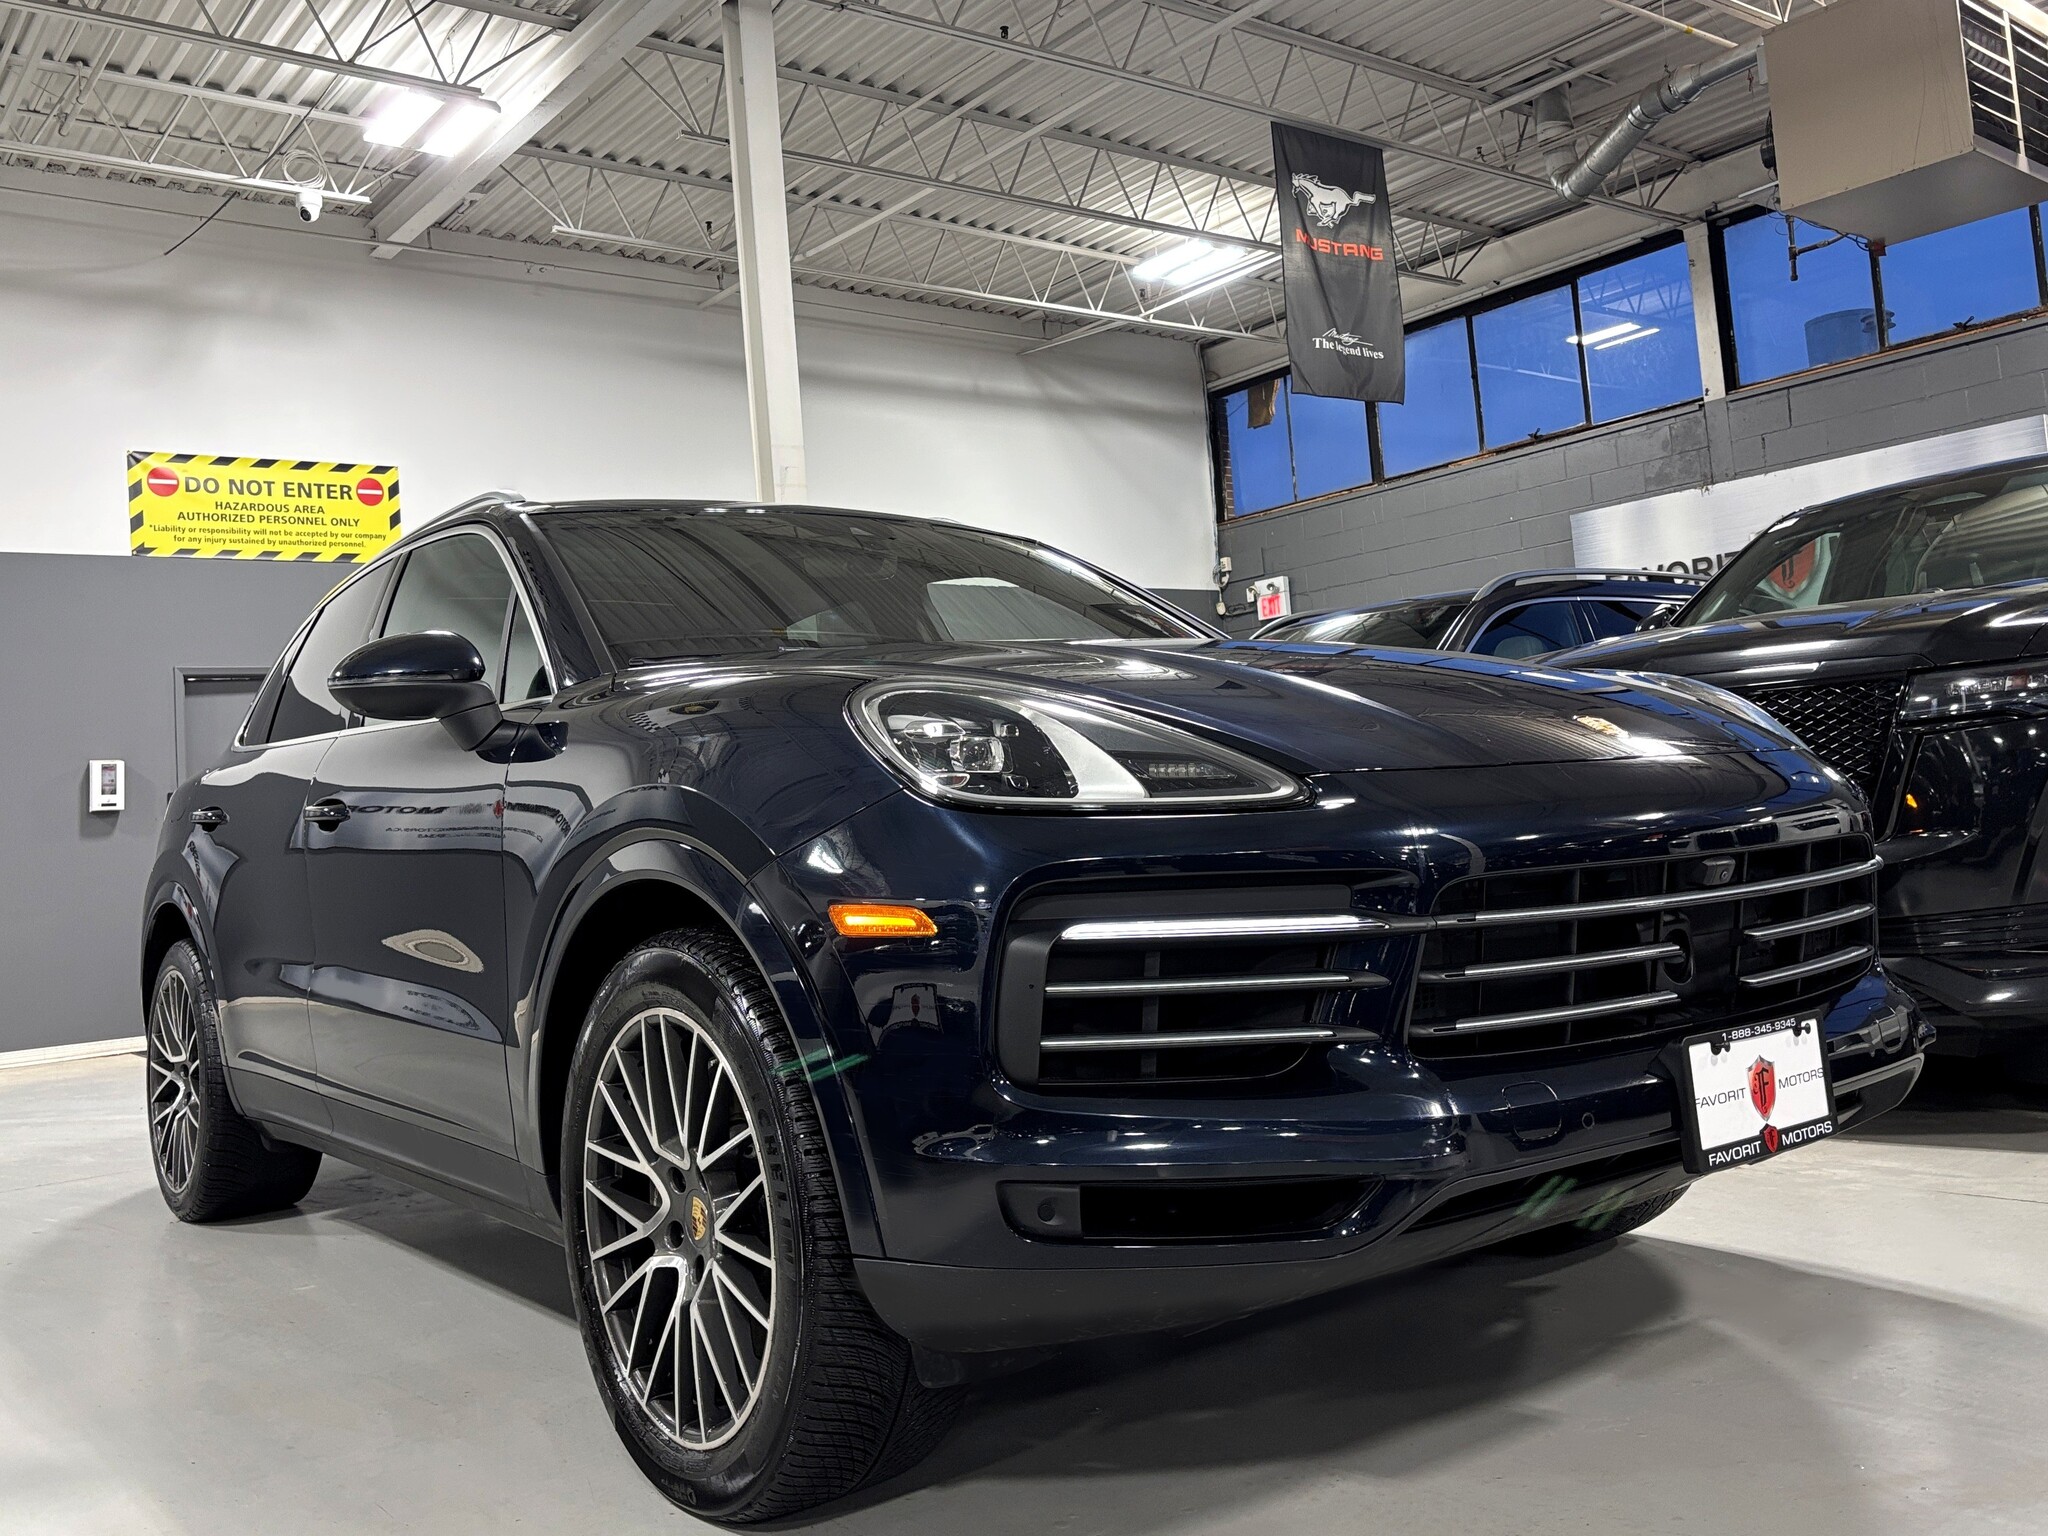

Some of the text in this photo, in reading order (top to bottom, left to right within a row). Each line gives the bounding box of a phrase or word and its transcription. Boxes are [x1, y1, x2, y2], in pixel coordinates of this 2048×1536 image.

[1295, 228, 1384, 261] MUSTANG
[1312, 337, 1384, 360] The legend lives
[184, 476, 353, 501] DO NOT ENTER
[215, 501, 325, 515] HAZARDOUS AREA
[177, 512, 360, 528] AUTHORIZED PERSONNEL ONLY
[199, 527, 251, 536] responsibility
[295, 531, 328, 539] accepted
[330, 531, 339, 539] by
[354, 533, 387, 541] company
[204, 536, 227, 544] injury
[228, 537, 265, 545] sustained
[267, 538, 276, 546] by
[278, 539, 327, 547] unauthorized
[328, 541, 367, 549] personnel.
[1721, 1018, 1797, 1042] 1-888-345-9345
[1695, 1087, 1747, 1109] FAVORIT
[1778, 1067, 1824, 1090] MOTORS
[1708, 1140, 1762, 1167] FAVORIT
[1781, 1120, 1833, 1146] MOTORS
